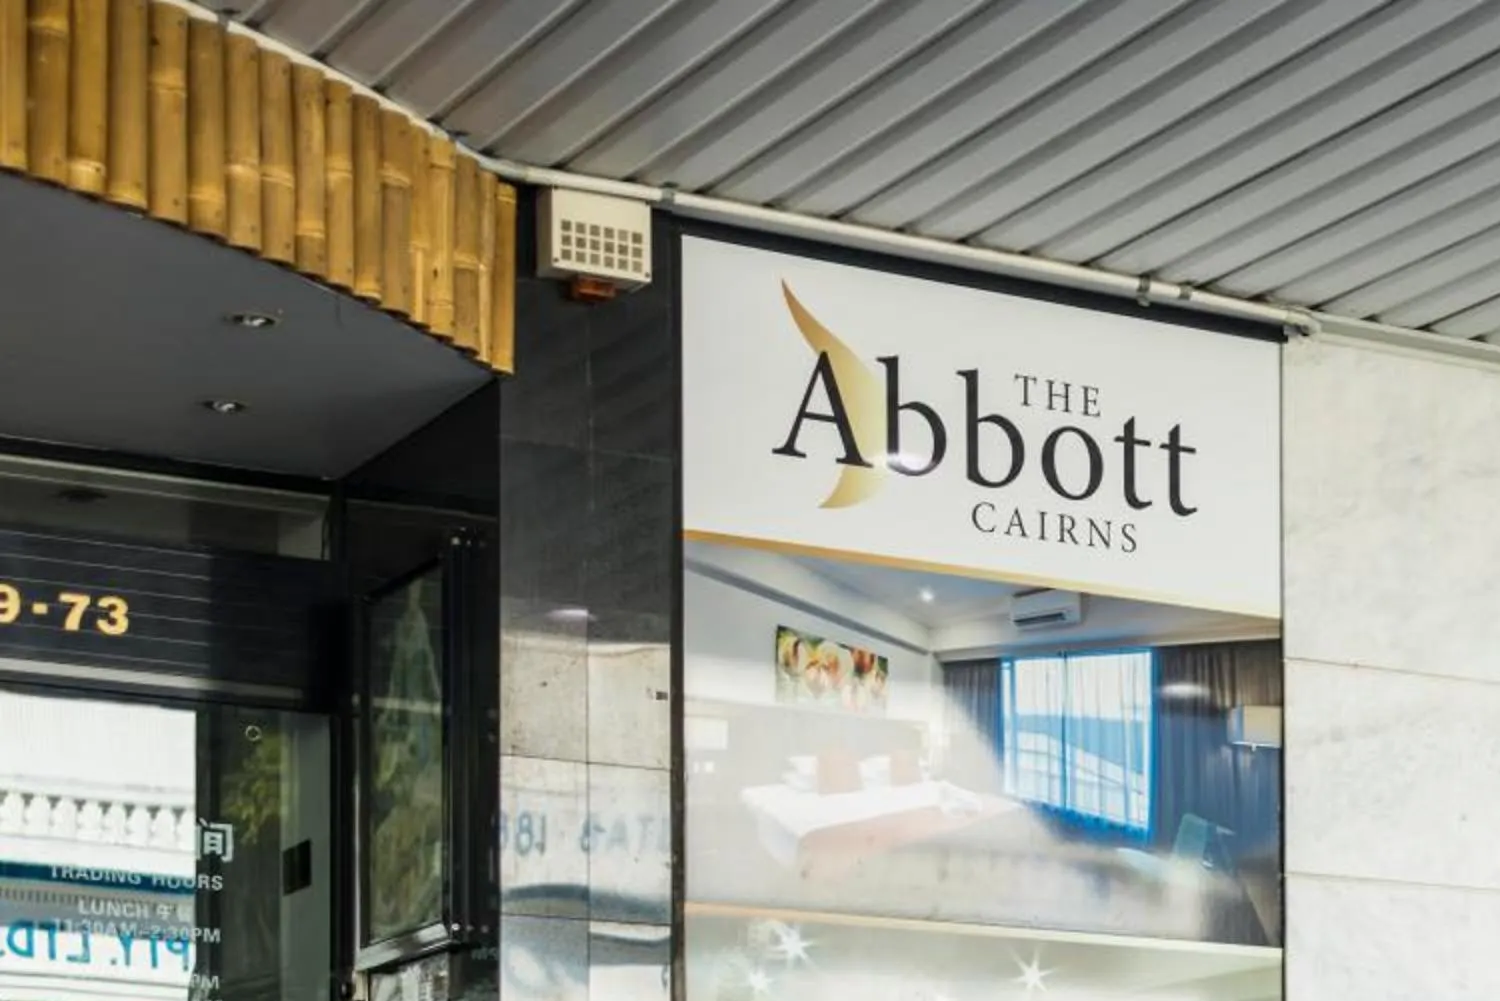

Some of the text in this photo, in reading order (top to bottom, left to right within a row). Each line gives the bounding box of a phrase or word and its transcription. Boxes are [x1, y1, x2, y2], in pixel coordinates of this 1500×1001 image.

[1014, 374, 1101, 418] THE
[772, 351, 1198, 517] Abbott
[971, 501, 1139, 555] CAIRNS
[50, 864, 224, 892] TRADING HOURS
[78, 899, 150, 920] LUNCH
